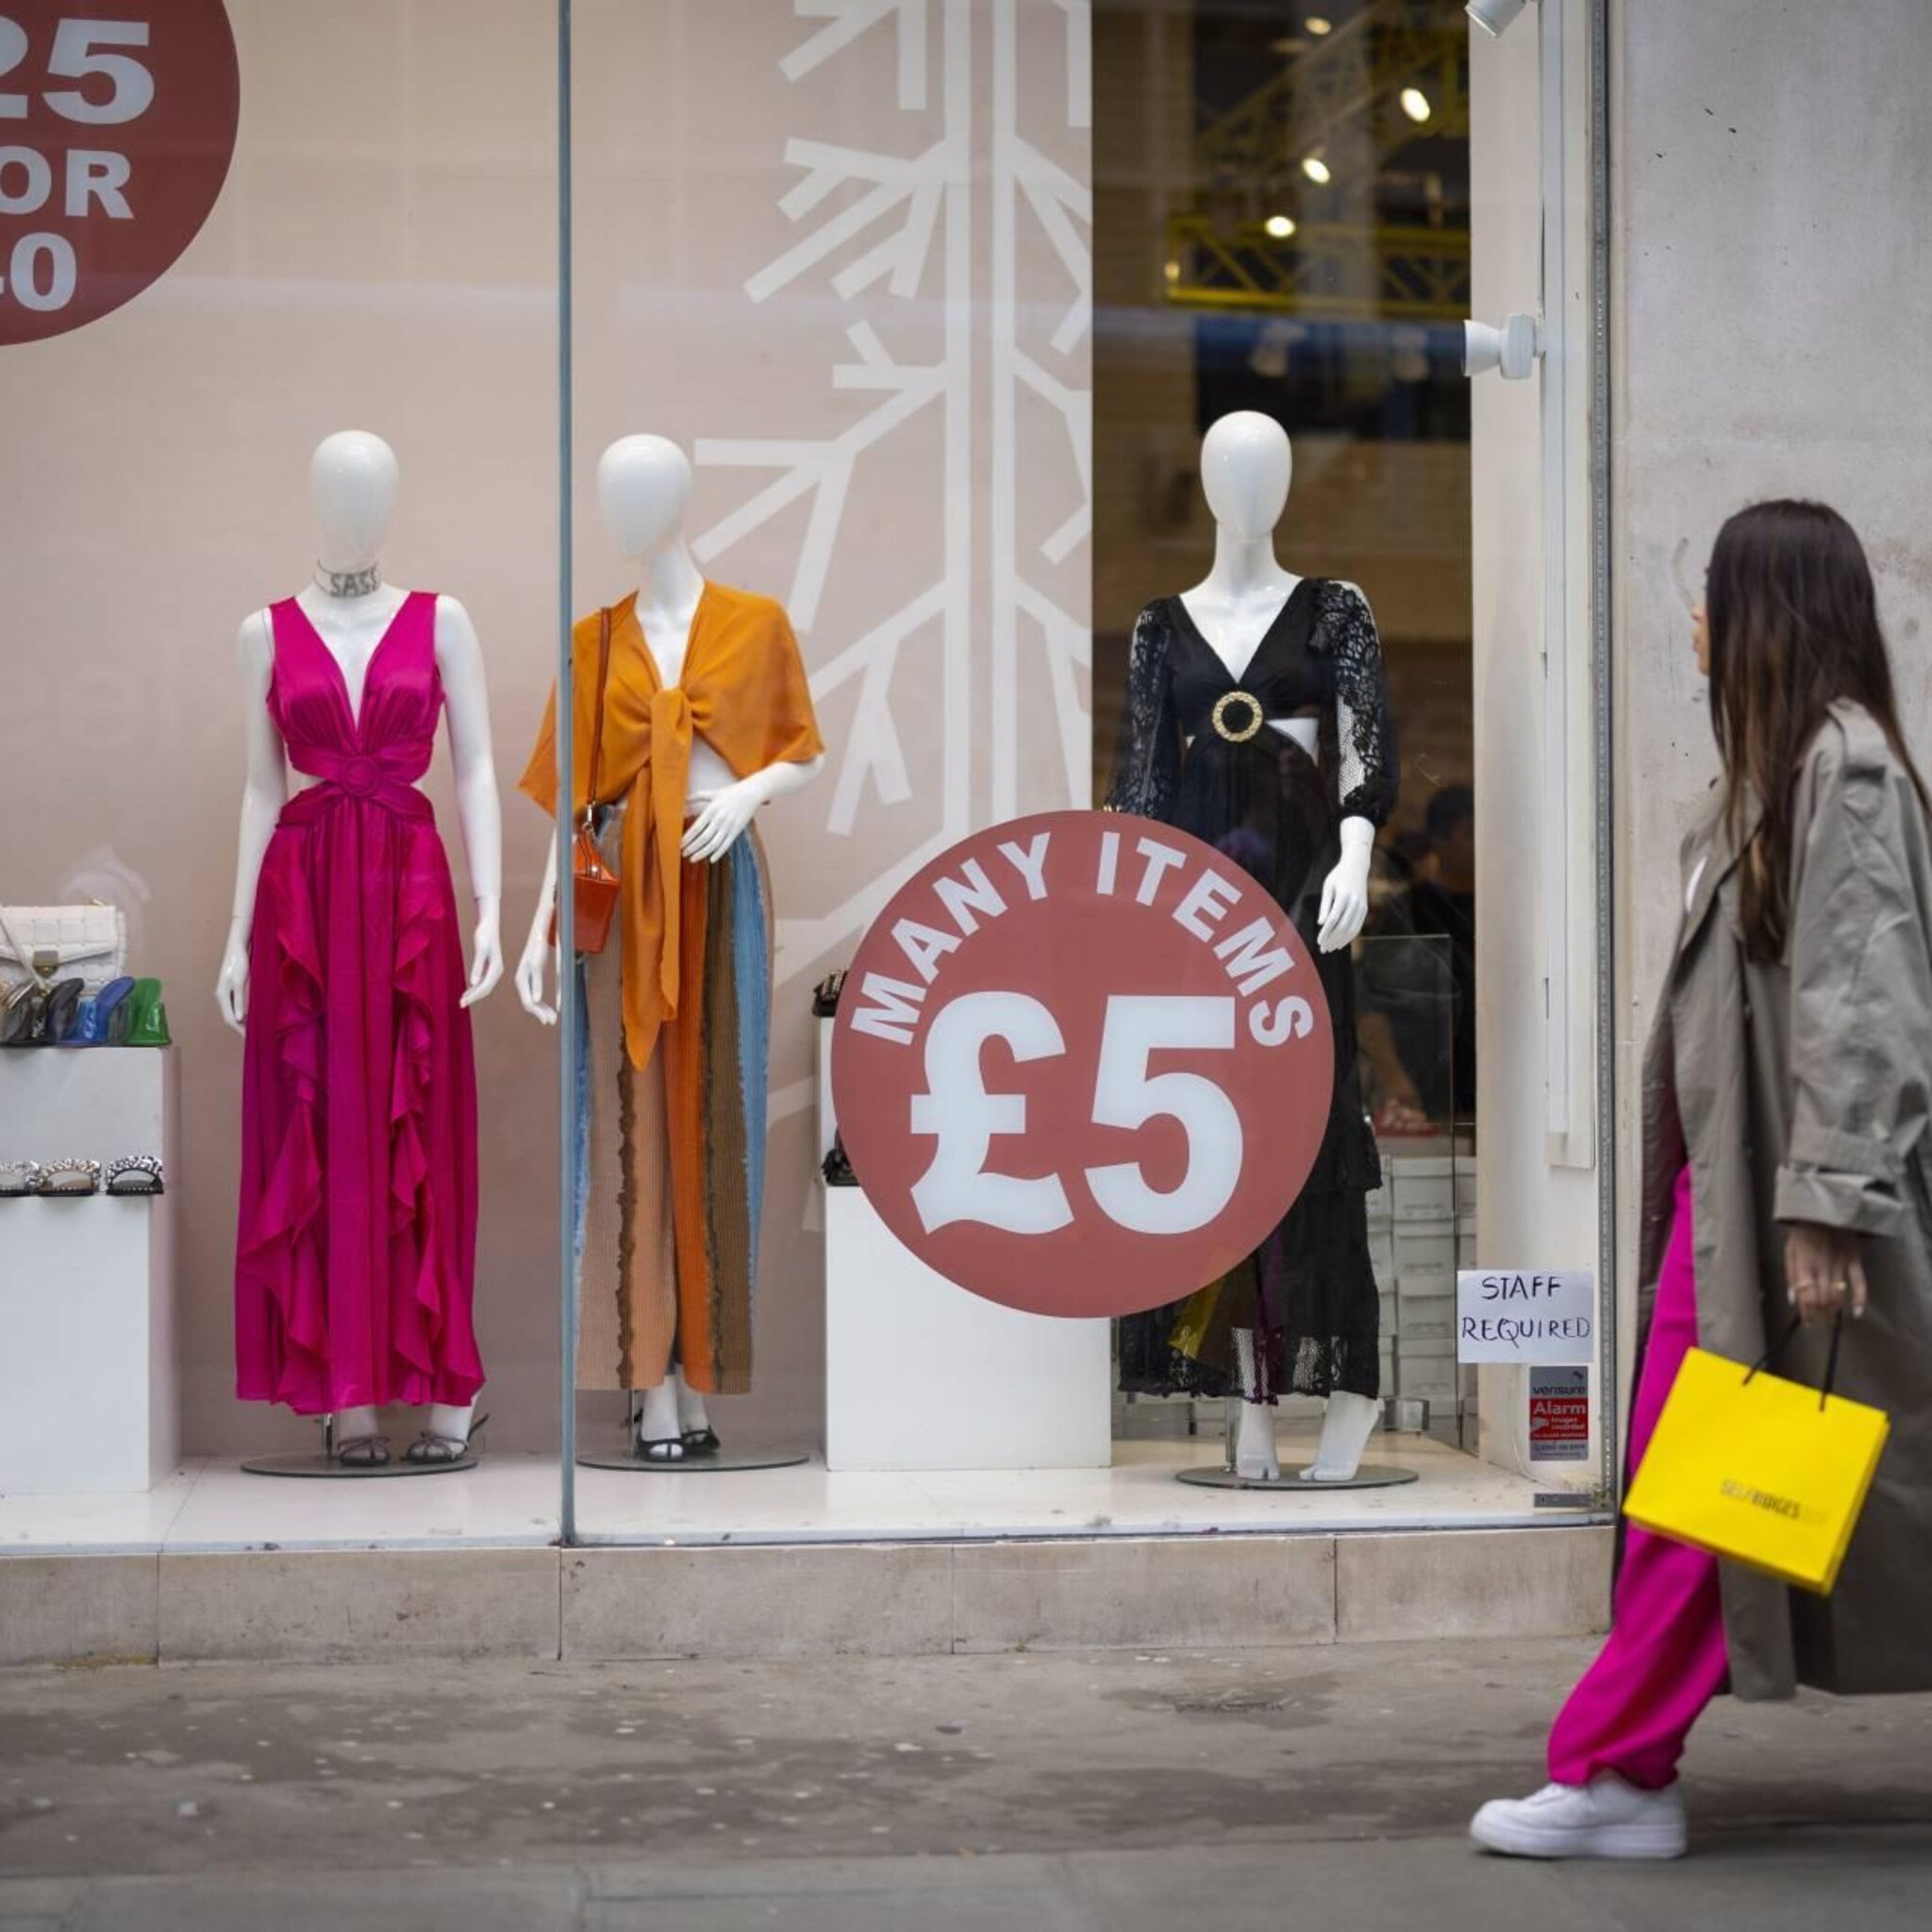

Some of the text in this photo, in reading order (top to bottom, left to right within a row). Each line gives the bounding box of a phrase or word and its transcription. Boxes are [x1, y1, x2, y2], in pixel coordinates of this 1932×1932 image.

[849, 831, 1314, 1047] MANY ITEMS
[909, 991, 1244, 1236] £5
[1481, 1275, 1564, 1300] STAFF
[1462, 1317, 1591, 1349] REQUIRED
[1533, 1400, 1586, 1414] Alarm
